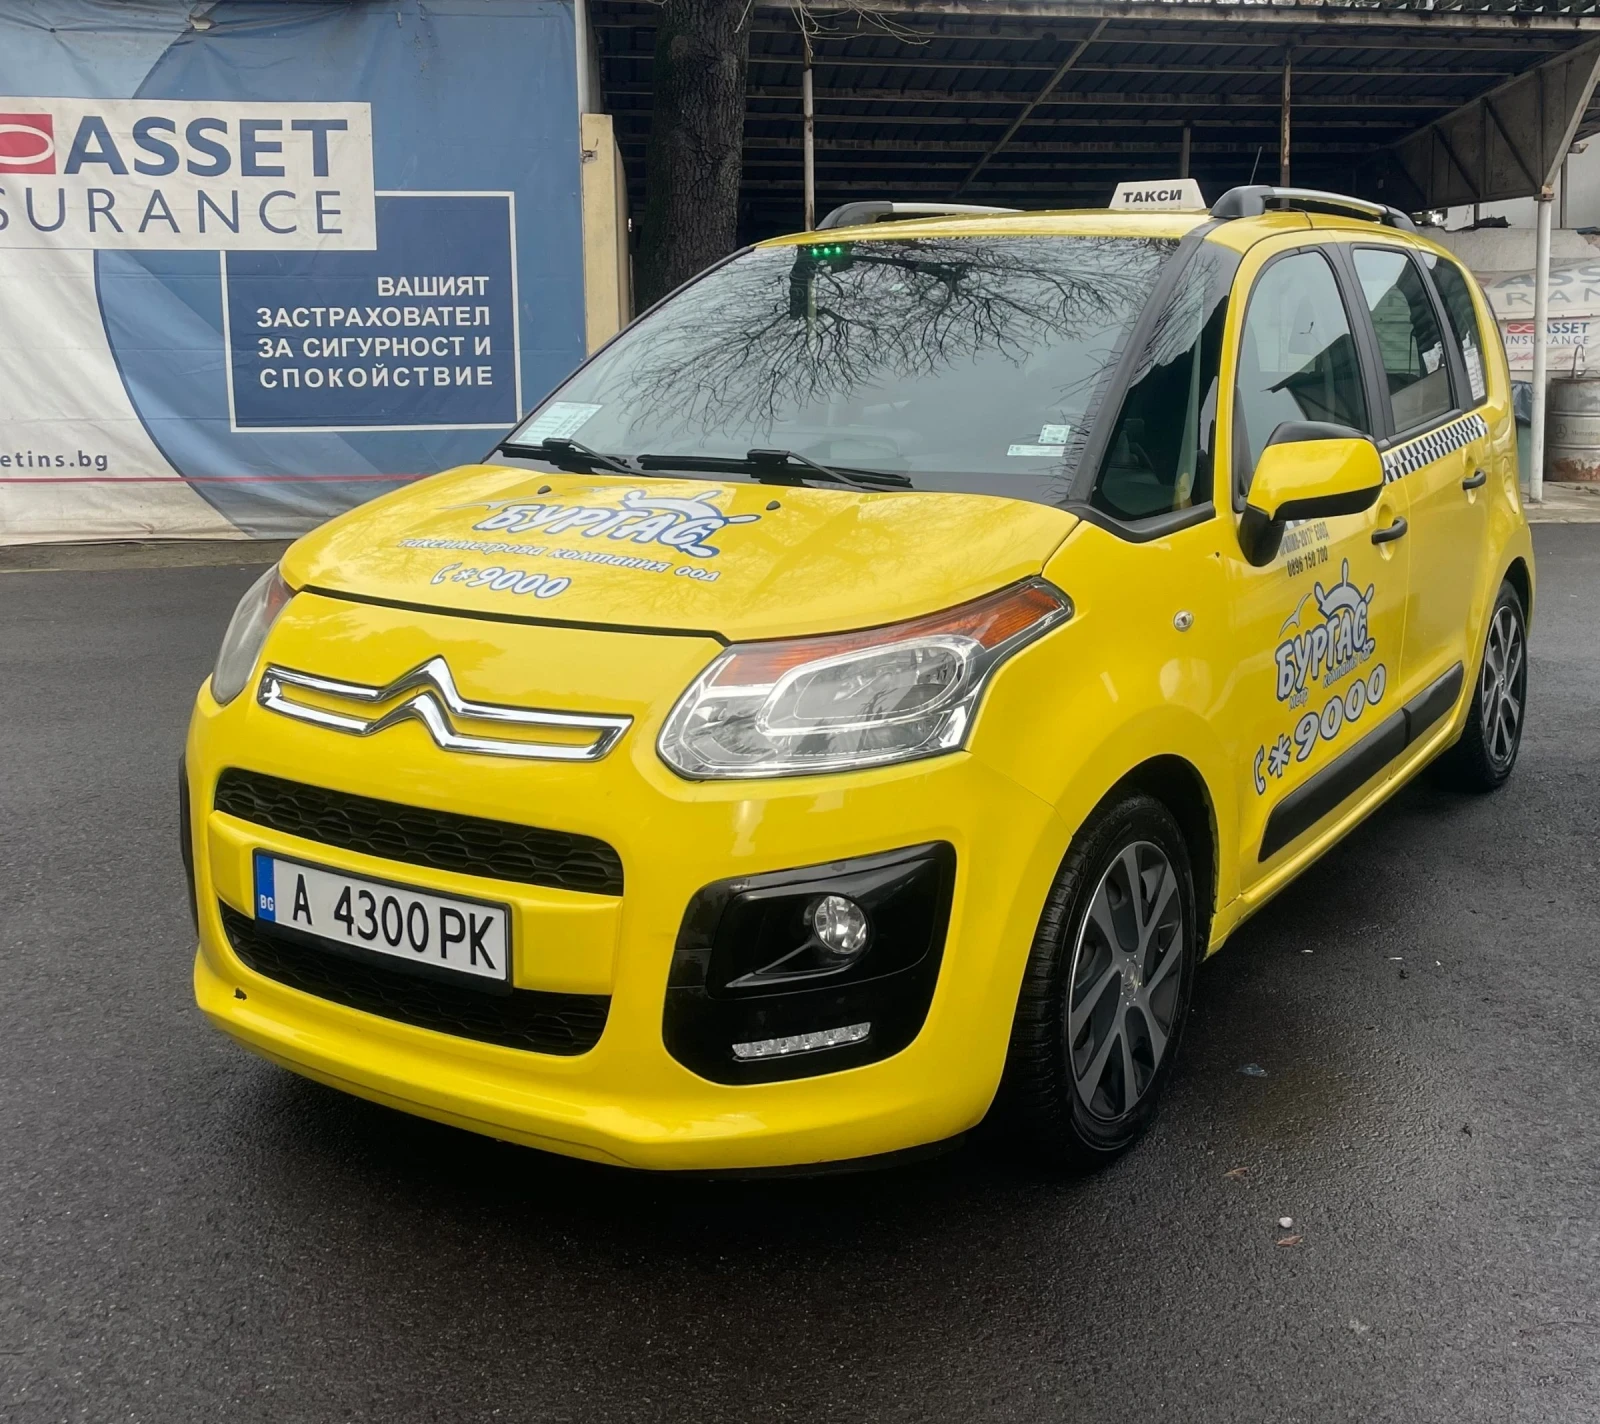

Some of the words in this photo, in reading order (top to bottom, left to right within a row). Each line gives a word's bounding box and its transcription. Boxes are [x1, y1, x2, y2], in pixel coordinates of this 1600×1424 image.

[63, 115, 348, 178] ASSET
[1123, 189, 1182, 203] ТАКСИ
[377, 276, 490, 297] ВАШИЯТ
[256, 306, 491, 328] ЗАСТРАХОВАТЕЛ
[257, 338, 294, 359] ЗА
[302, 336, 465, 358] СИГУРНОСТ
[474, 336, 492, 356] И
[259, 364, 494, 389] СПОКОЙСТВИЕ
[0, 450, 108, 471] etins.bg
[472, 502, 728, 552] БУРГАС
[397, 538, 548, 555] таксиметрова
[548, 548, 674, 573] компания
[674, 566, 721, 582] оод
[1275, 600, 1368, 703] БУРГАС
[260, 894, 274, 911] BG
[293, 873, 313, 925] A
[333, 885, 430, 953] 4300
[439, 906, 497, 970] PK
